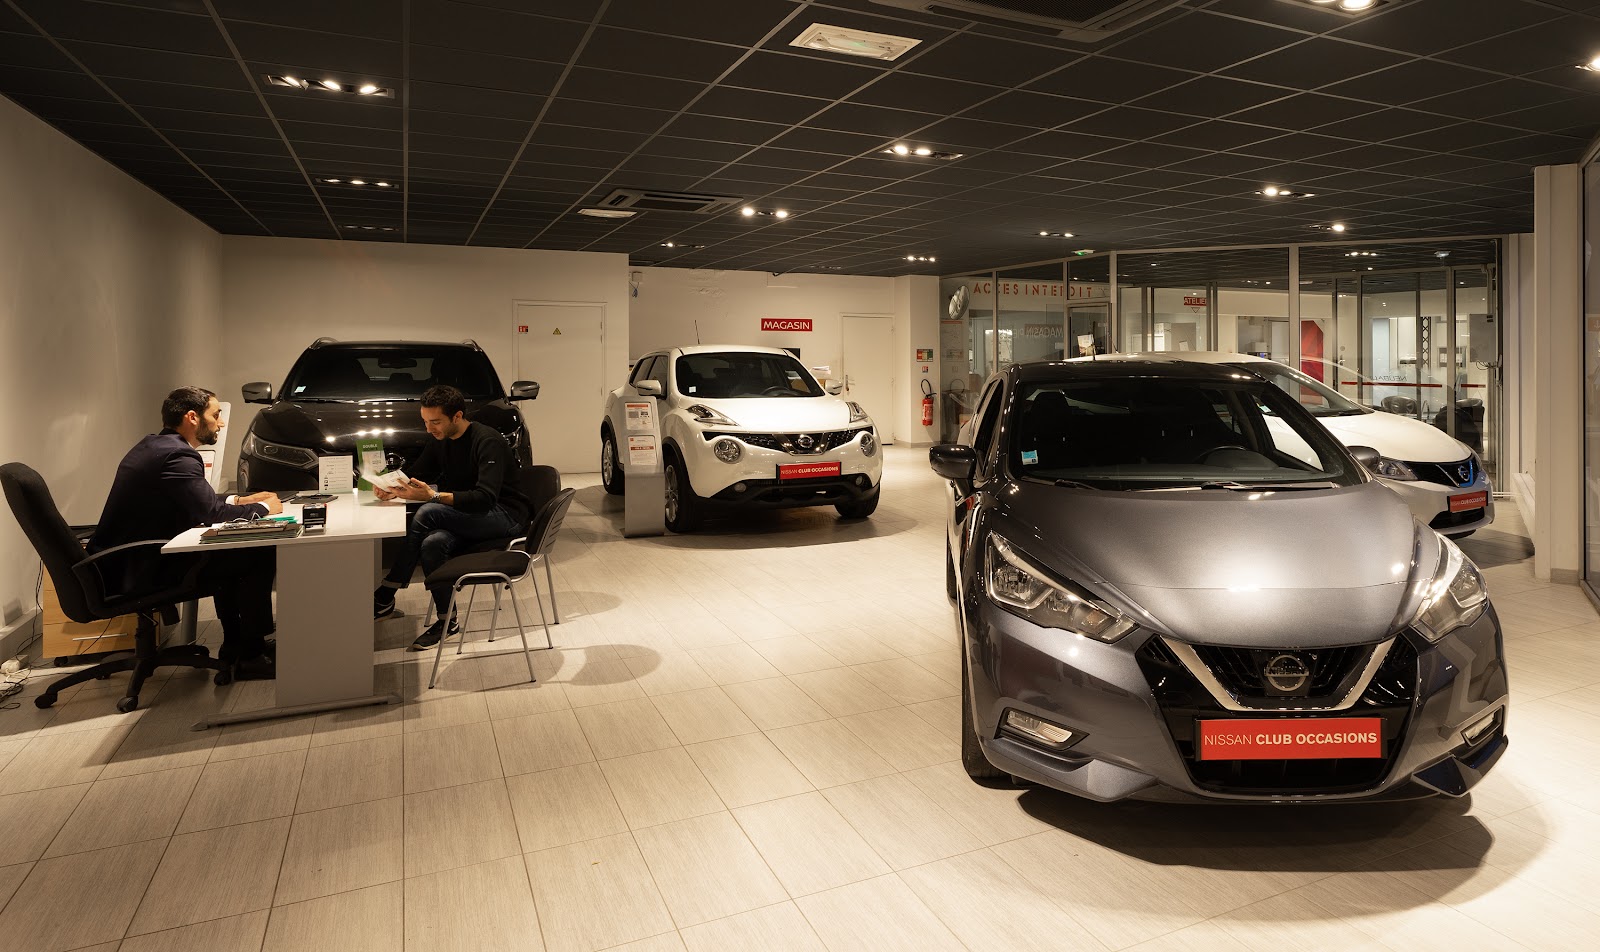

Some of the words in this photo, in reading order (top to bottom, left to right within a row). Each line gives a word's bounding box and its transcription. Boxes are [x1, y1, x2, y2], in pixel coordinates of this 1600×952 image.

[973, 282, 1019, 295] ACES
[1025, 283, 1092, 298] INTEDIT
[1184, 297, 1207, 305] ATELIE
[763, 321, 810, 330] MAGASIN
[1204, 734, 1252, 746] NISSAN
[1255, 733, 1293, 745] CLUB
[1295, 732, 1378, 745] OCCASIONS
